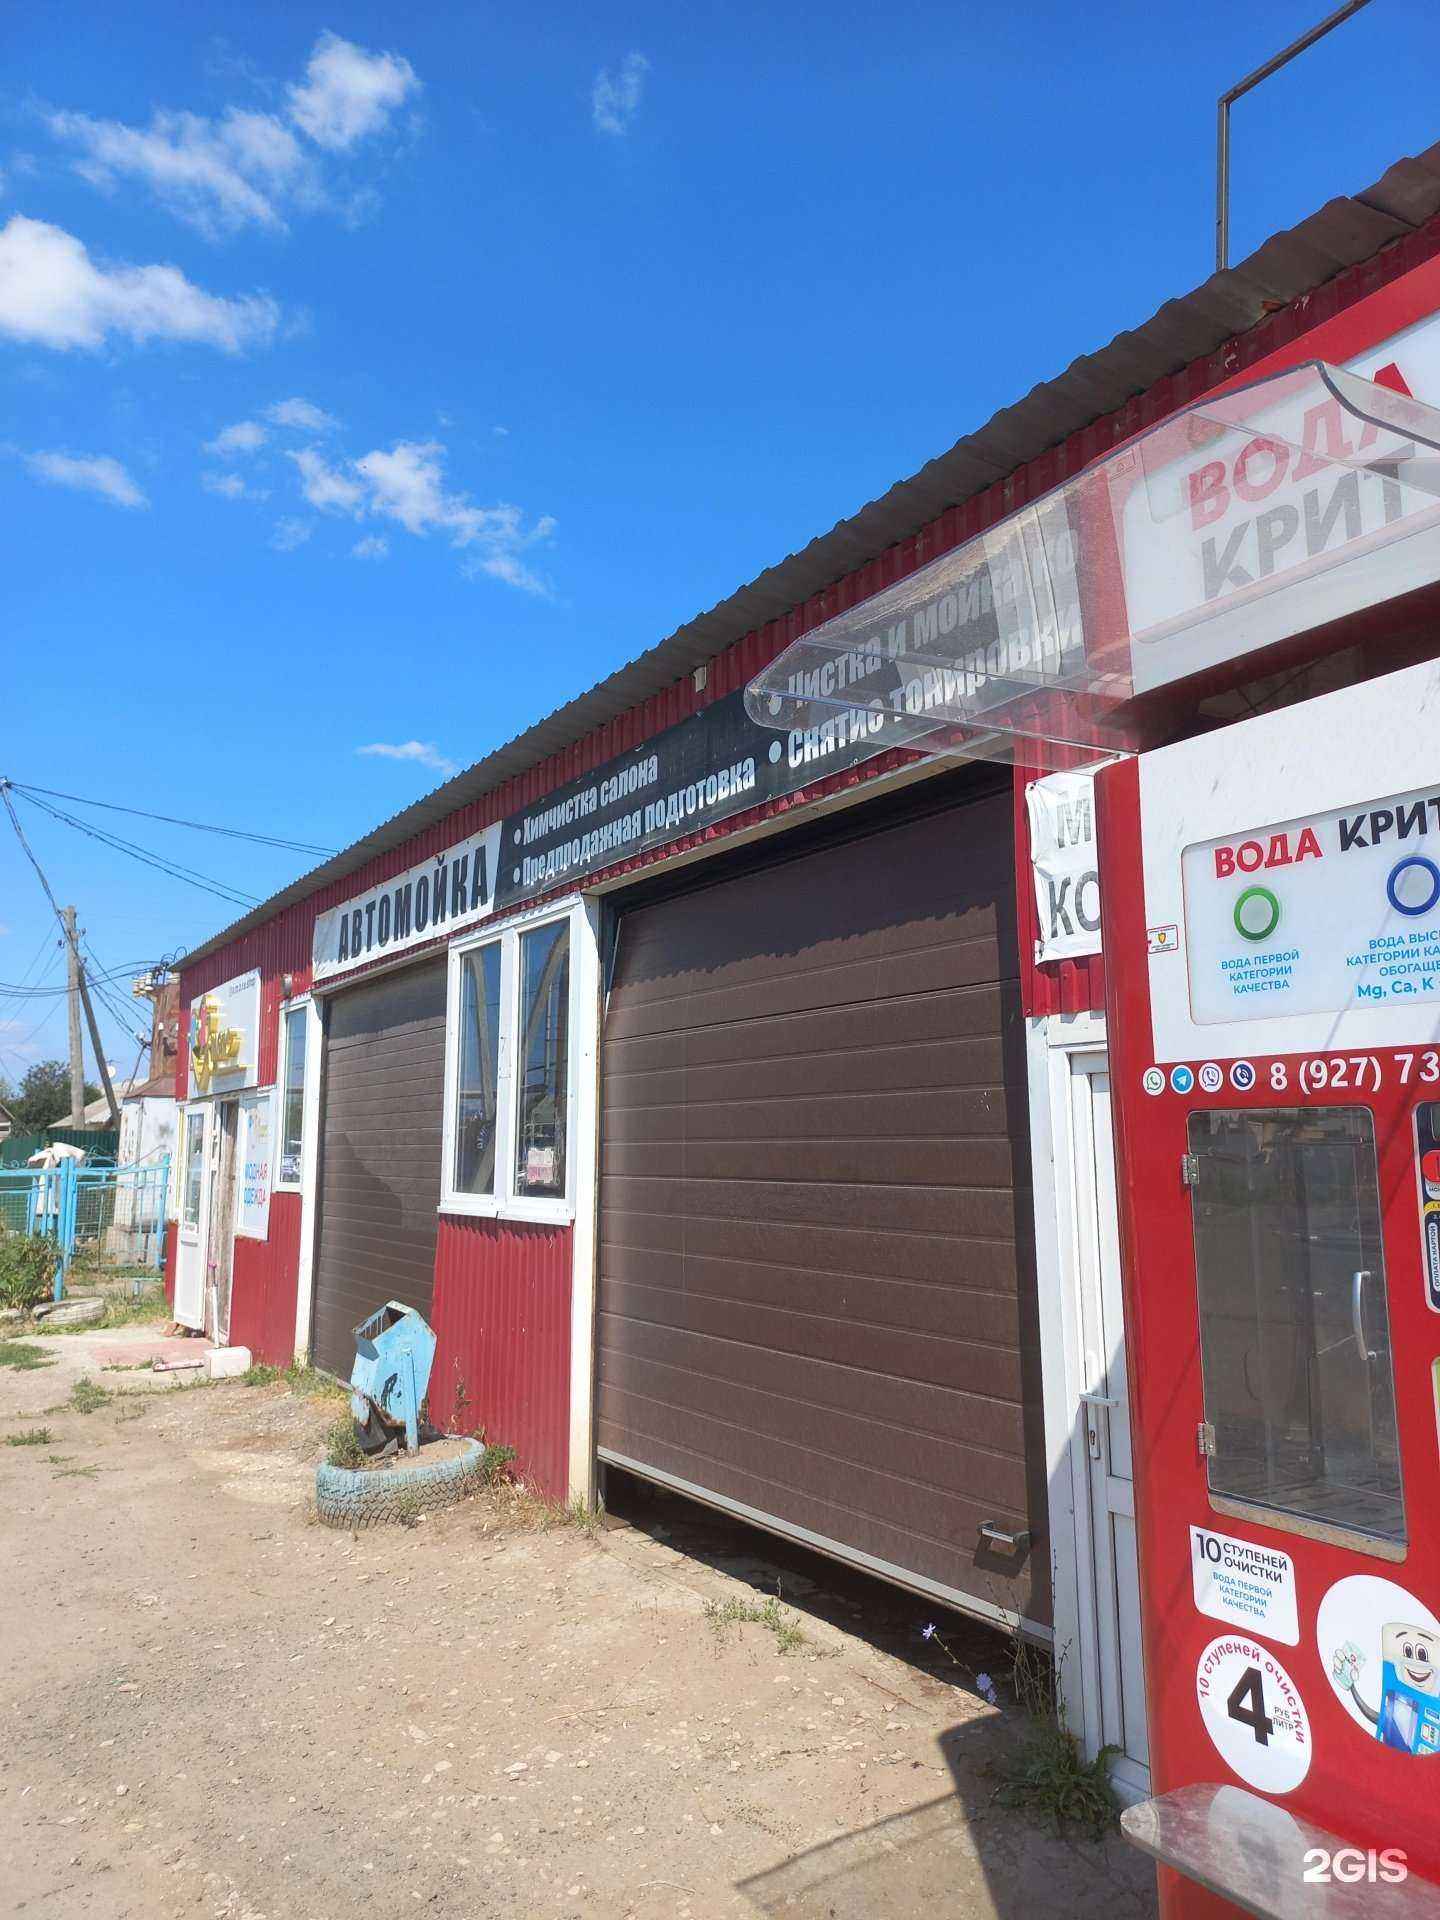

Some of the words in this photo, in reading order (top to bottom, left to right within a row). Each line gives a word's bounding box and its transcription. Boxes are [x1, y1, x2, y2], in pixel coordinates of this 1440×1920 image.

[523, 785, 598, 845] Химчистка
[600, 755, 658, 807] салона
[522, 810, 641, 886] Предпродажная
[645, 757, 756, 833] подготовка
[1214, 827, 1323, 878] ВОДА
[338, 845, 488, 963] АВТОМОЙКА
[1369, 936, 1405, 950] ВОДА
[1409, 930, 1440, 944] ВЫС
[1221, 958, 1251, 970] ВОДА
[1254, 949, 1300, 965] ПЕРВОЙ
[1346, 948, 1420, 967] КАТЕГОРИИ
[1229, 965, 1292, 982] КАТЕГОРИИ
[1233, 979, 1290, 994] КАЧЕСТВА
[1357, 984, 1387, 999] Mg,
[1391, 980, 1418, 994] Ca,
[1270, 1062, 1288, 1091] 8
[1299, 1056, 1382, 1095] (927)
[1196, 1533, 1221, 1563] 10
[1223, 1542, 1287, 1571] СТУПЕНЕЙ
[1224, 1556, 1282, 1583] ОЧИСТКИ
[1213, 1571, 1236, 1585] ВОДА
[1238, 1579, 1272, 1598] ПЕРВОЙ
[1219, 1585, 1267, 1608] КАТЕГОРИИ
[1222, 1596, 1266, 1618] КАЧЕСТВА
[1227, 1666, 1274, 1747] 4
